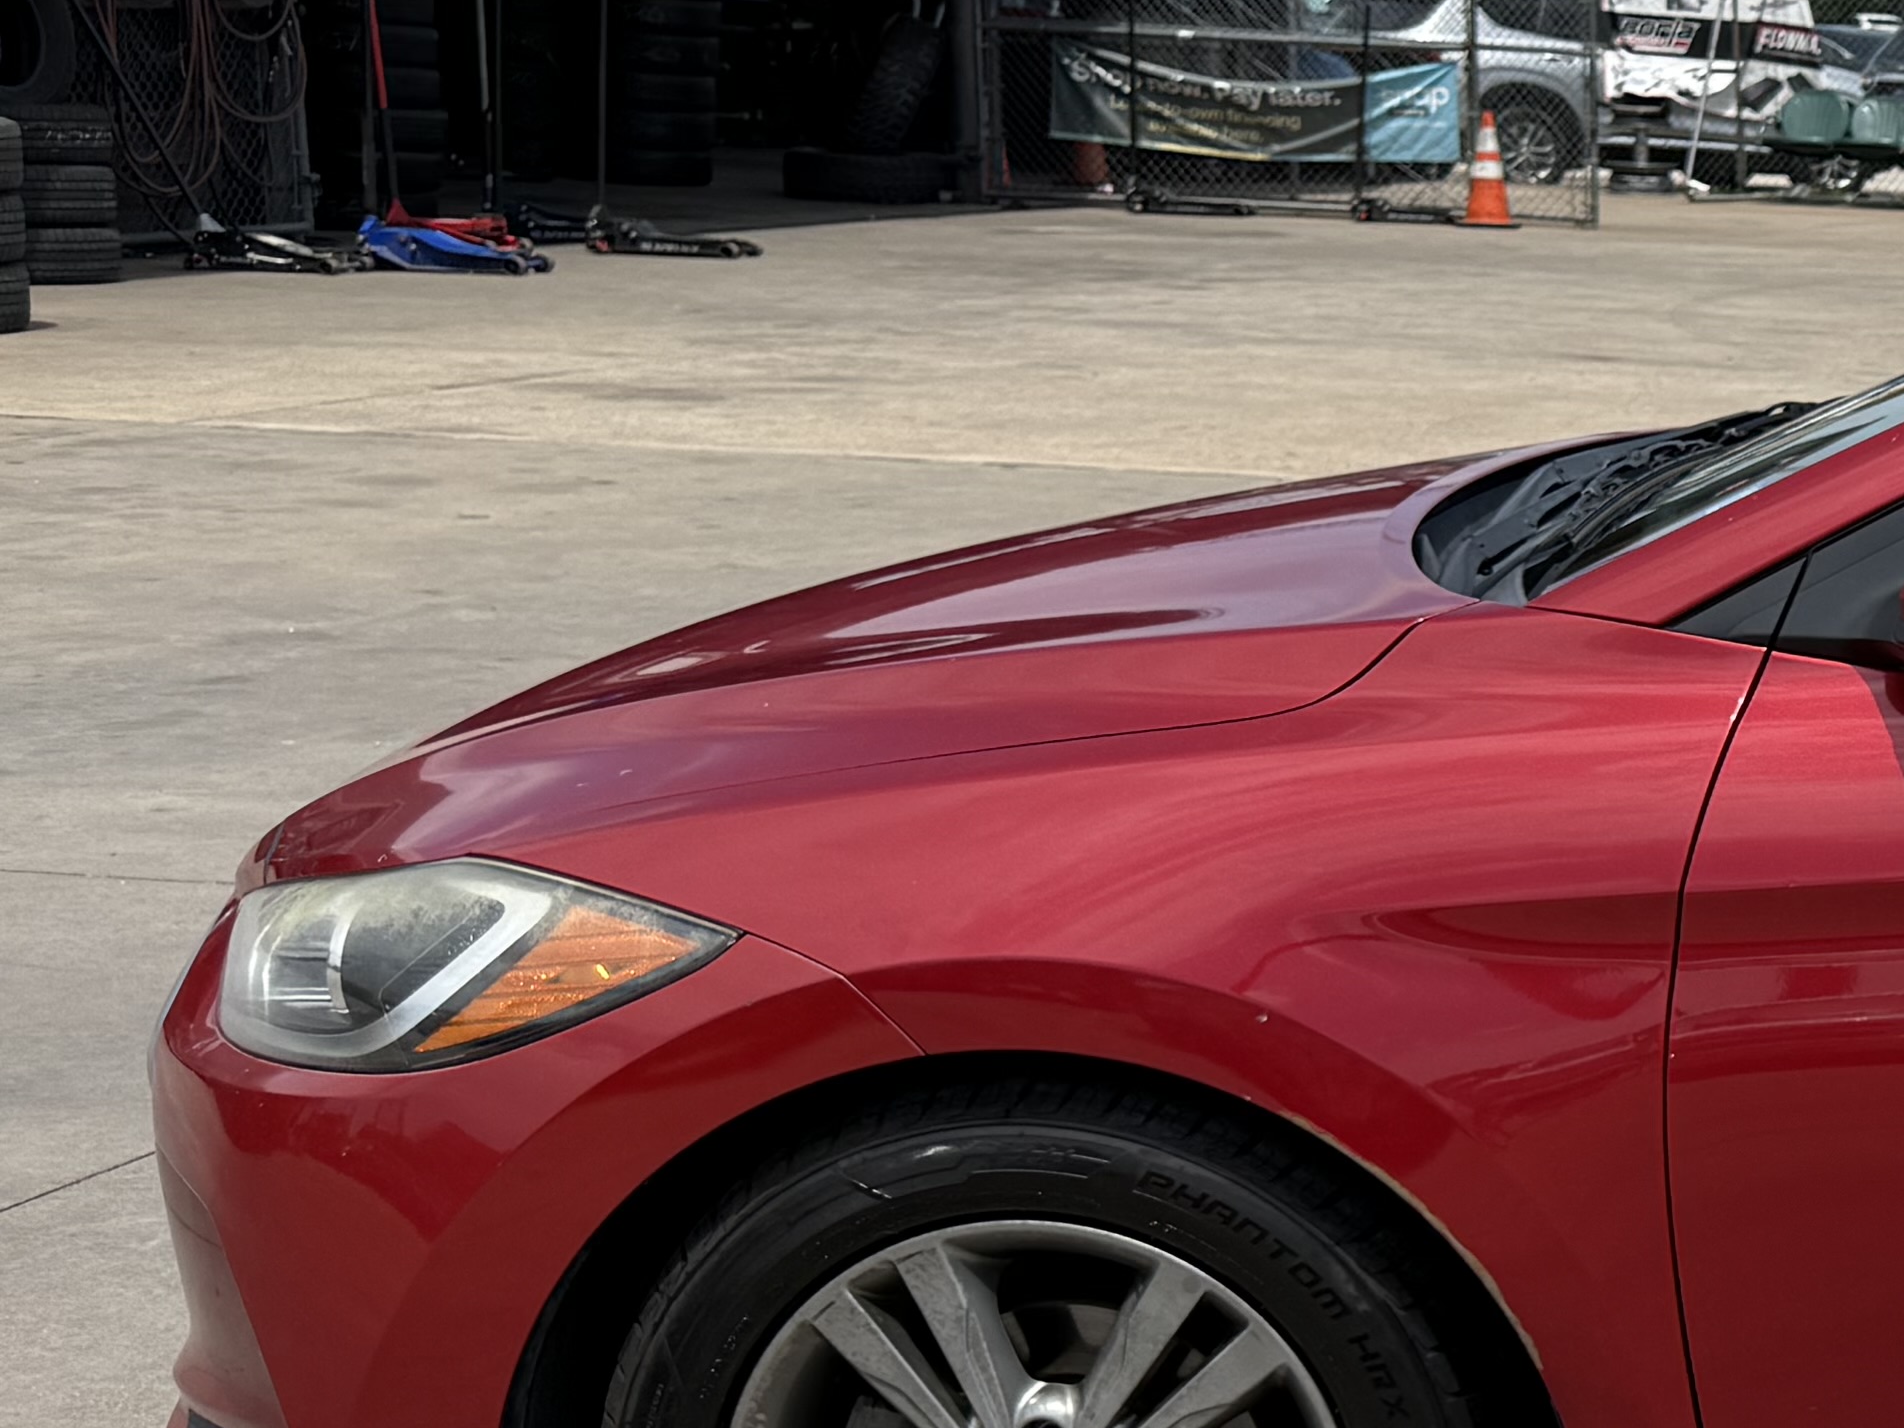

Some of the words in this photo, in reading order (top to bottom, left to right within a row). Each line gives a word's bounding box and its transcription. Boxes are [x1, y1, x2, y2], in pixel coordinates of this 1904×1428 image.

[1212, 80, 1263, 110] Pay
[1268, 85, 1343, 108] later.
[1134, 1171, 1348, 1320] PHANTOM
[1348, 1332, 1411, 1421] HRX
